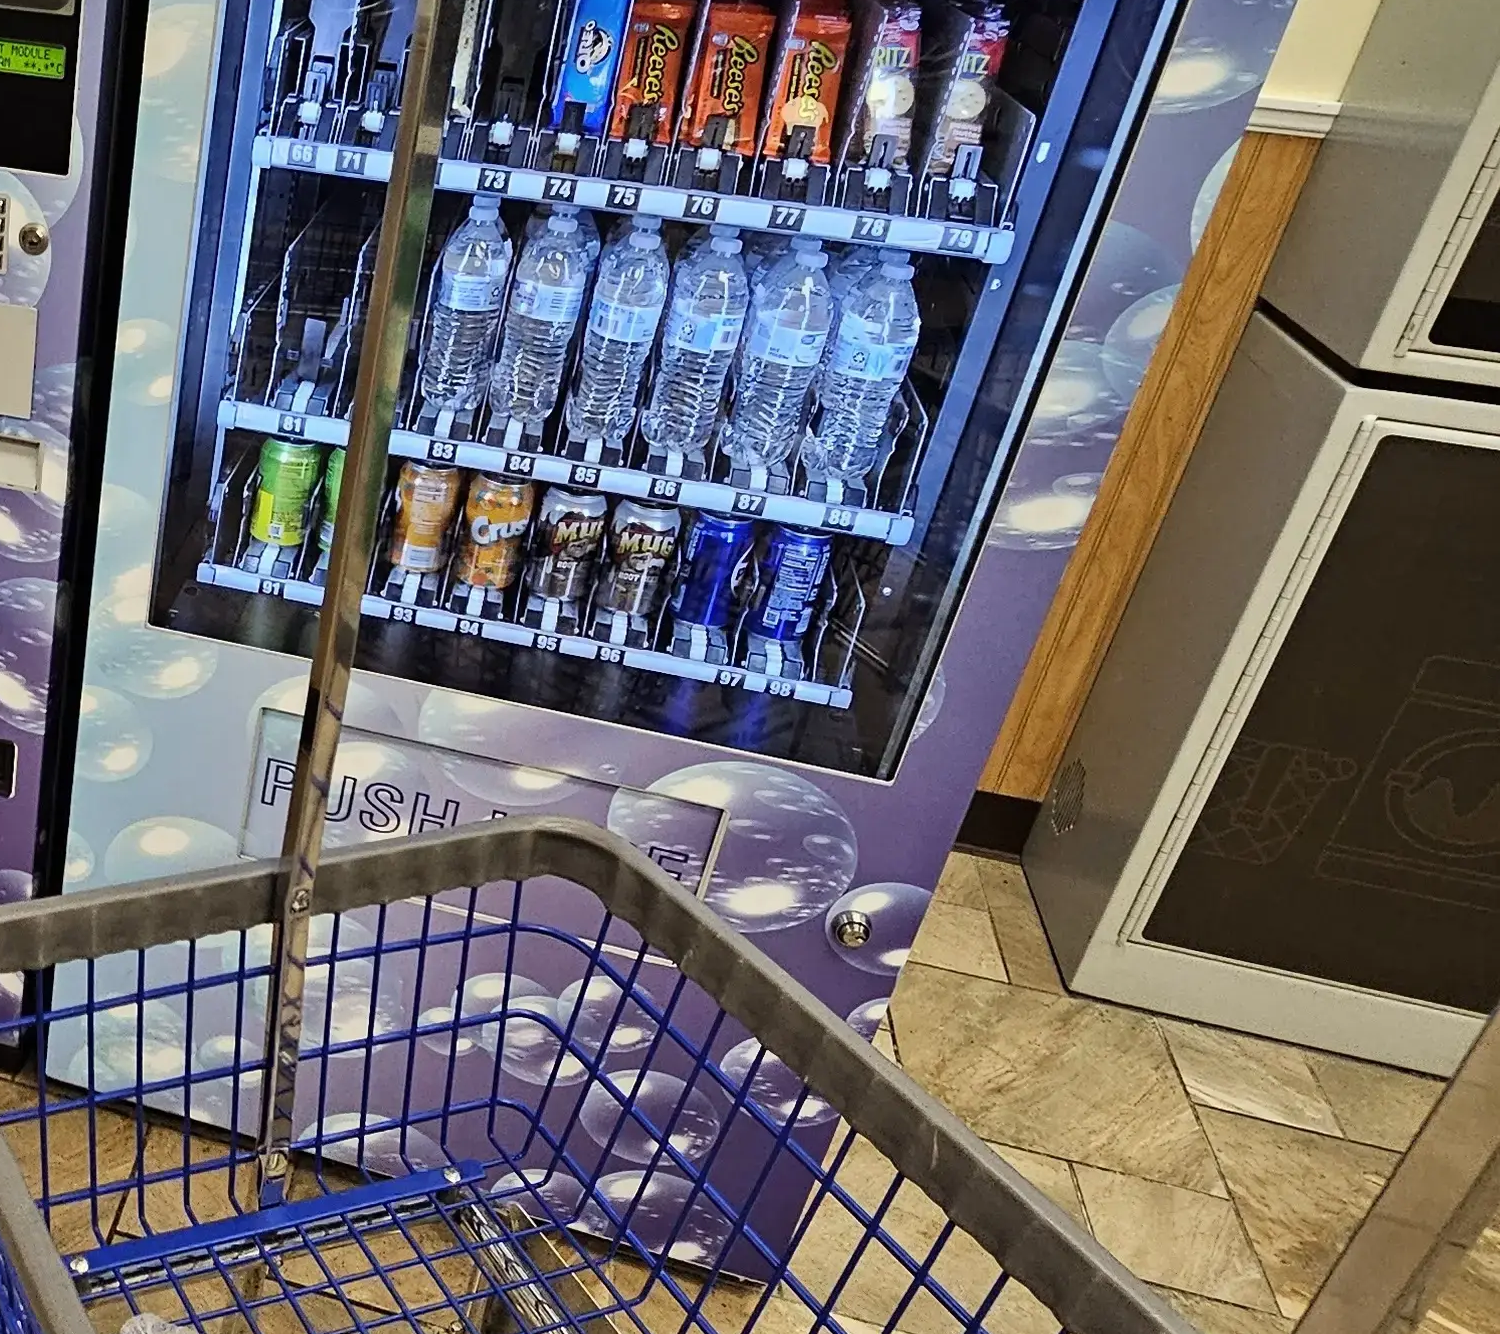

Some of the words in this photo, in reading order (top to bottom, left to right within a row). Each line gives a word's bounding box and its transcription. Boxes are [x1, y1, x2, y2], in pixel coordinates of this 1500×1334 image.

[11, 45, 50, 61] MODULE
[576, 20, 597, 75] OREO
[644, 23, 679, 105] Reese's
[722, 34, 759, 115] Reese's
[874, 45, 911, 69] RITZ
[964, 53, 991, 73] ITZ
[799, 41, 837, 123] Reese's
[291, 145, 313, 163] 66
[342, 151, 361, 169] 71
[483, 171, 506, 189] 73
[550, 179, 571, 198] 74
[613, 186, 636, 207] 75
[691, 196, 714, 216] 76
[775, 207, 800, 226] 77
[860, 218, 884, 237] 78
[950, 229, 972, 249] 79
[281, 417, 301, 432] 81
[432, 444, 453, 459] 83
[509, 455, 531, 473] 84
[574, 468, 597, 484] 85
[655, 480, 677, 496] 86
[738, 495, 761, 511] 87
[827, 509, 851, 525] 88
[471, 513, 530, 545] Crus
[619, 531, 676, 556] MUG
[618, 571, 641, 583] ROOT
[261, 580, 280, 596] 91
[393, 607, 413, 623] 93
[458, 620, 479, 636] 94
[536, 635, 558, 651] 95
[599, 647, 621, 663] 96
[720, 671, 741, 687] 97
[769, 681, 792, 697] 98
[261, 757, 460, 836] PUSH
